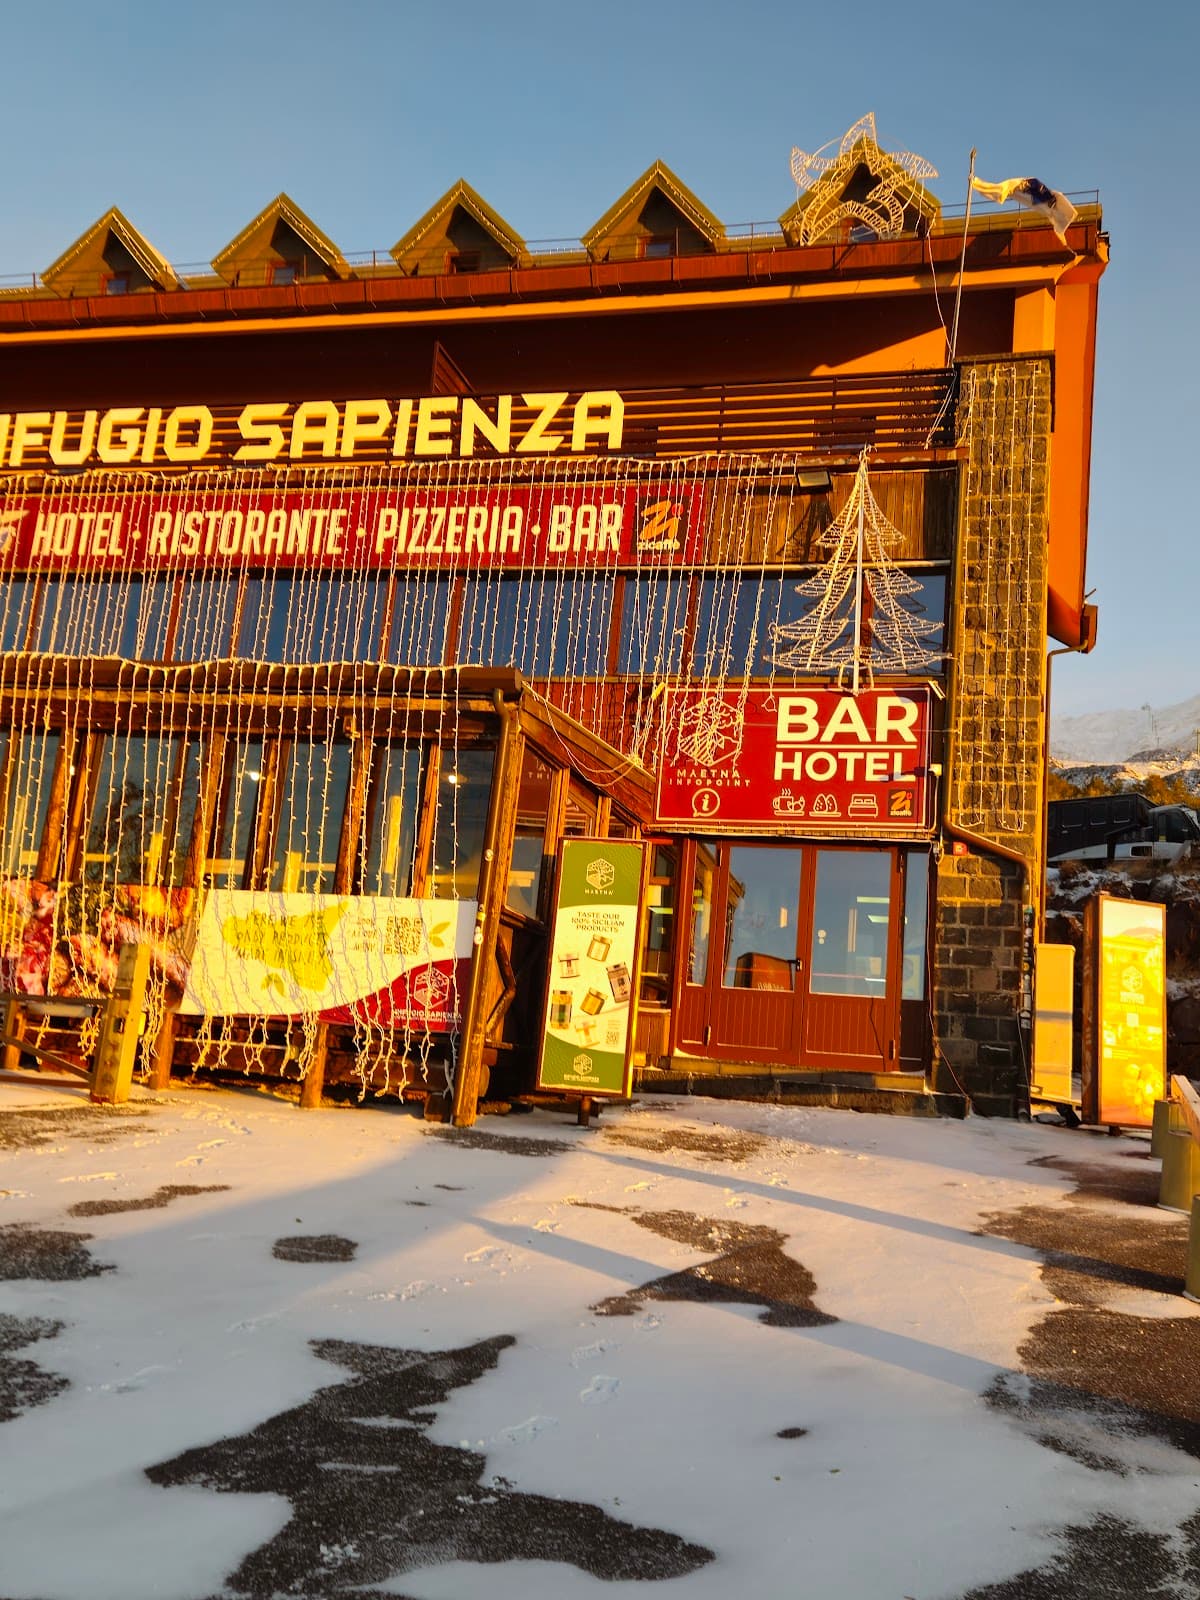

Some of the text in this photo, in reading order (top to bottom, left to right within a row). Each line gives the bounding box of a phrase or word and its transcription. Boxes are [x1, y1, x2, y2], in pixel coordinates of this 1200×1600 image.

[233, 390, 625, 461] SAPIENZA
[32, 503, 623, 557] HOTEL RISTORANTE PIZZERIA BAR
[776, 695, 919, 744] BAR
[773, 751, 916, 783] HOTEL
[677, 768, 741, 780] MAETNA
[669, 778, 751, 788] INFOPOINT
[577, 911, 600, 919] TASTE
[575, 924, 619, 933] PRODUCTS
[592, 919, 625, 927] SICILIAN
